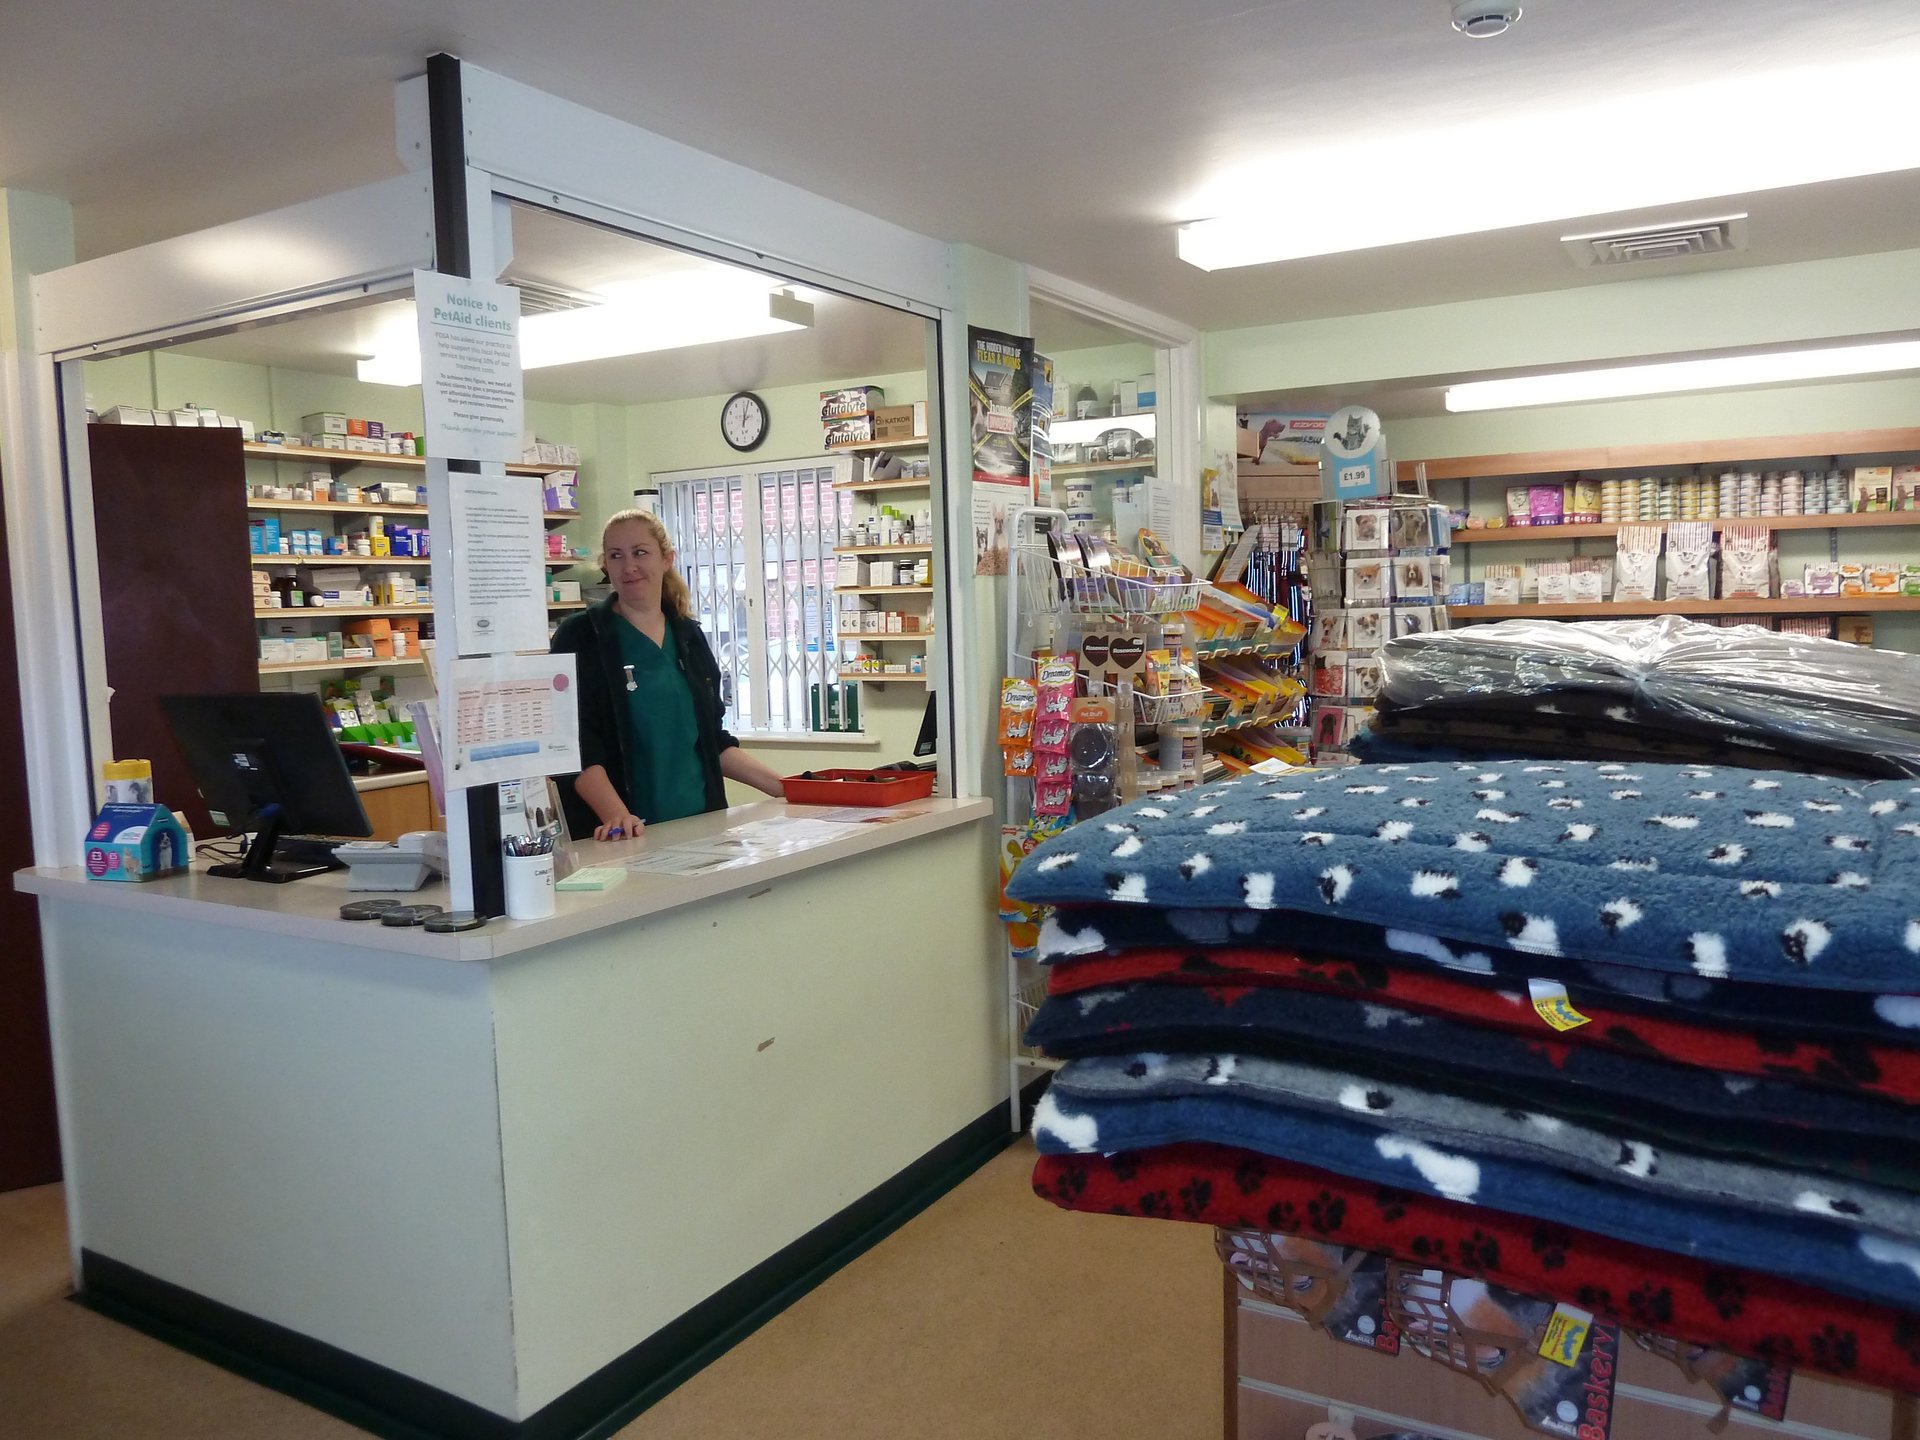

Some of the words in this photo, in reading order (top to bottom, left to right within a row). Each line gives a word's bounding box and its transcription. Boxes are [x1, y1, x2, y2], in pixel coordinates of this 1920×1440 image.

[447, 293, 483, 309] Notice
[487, 302, 498, 312] to
[434, 308, 471, 324] PetAid
[475, 316, 512, 330] clients
[976, 340, 985, 350] THE
[976, 349, 995, 364] FLEAS
[997, 354, 1001, 366] &
[1003, 355, 1021, 370] WORMS
[822, 402, 865, 416] Glutalyte
[826, 432, 869, 445] Glutalyte
[1344, 471, 1365, 480] £1.99
[1042, 668, 1071, 680] Dreamies
[1006, 692, 1034, 702] Dreamies
